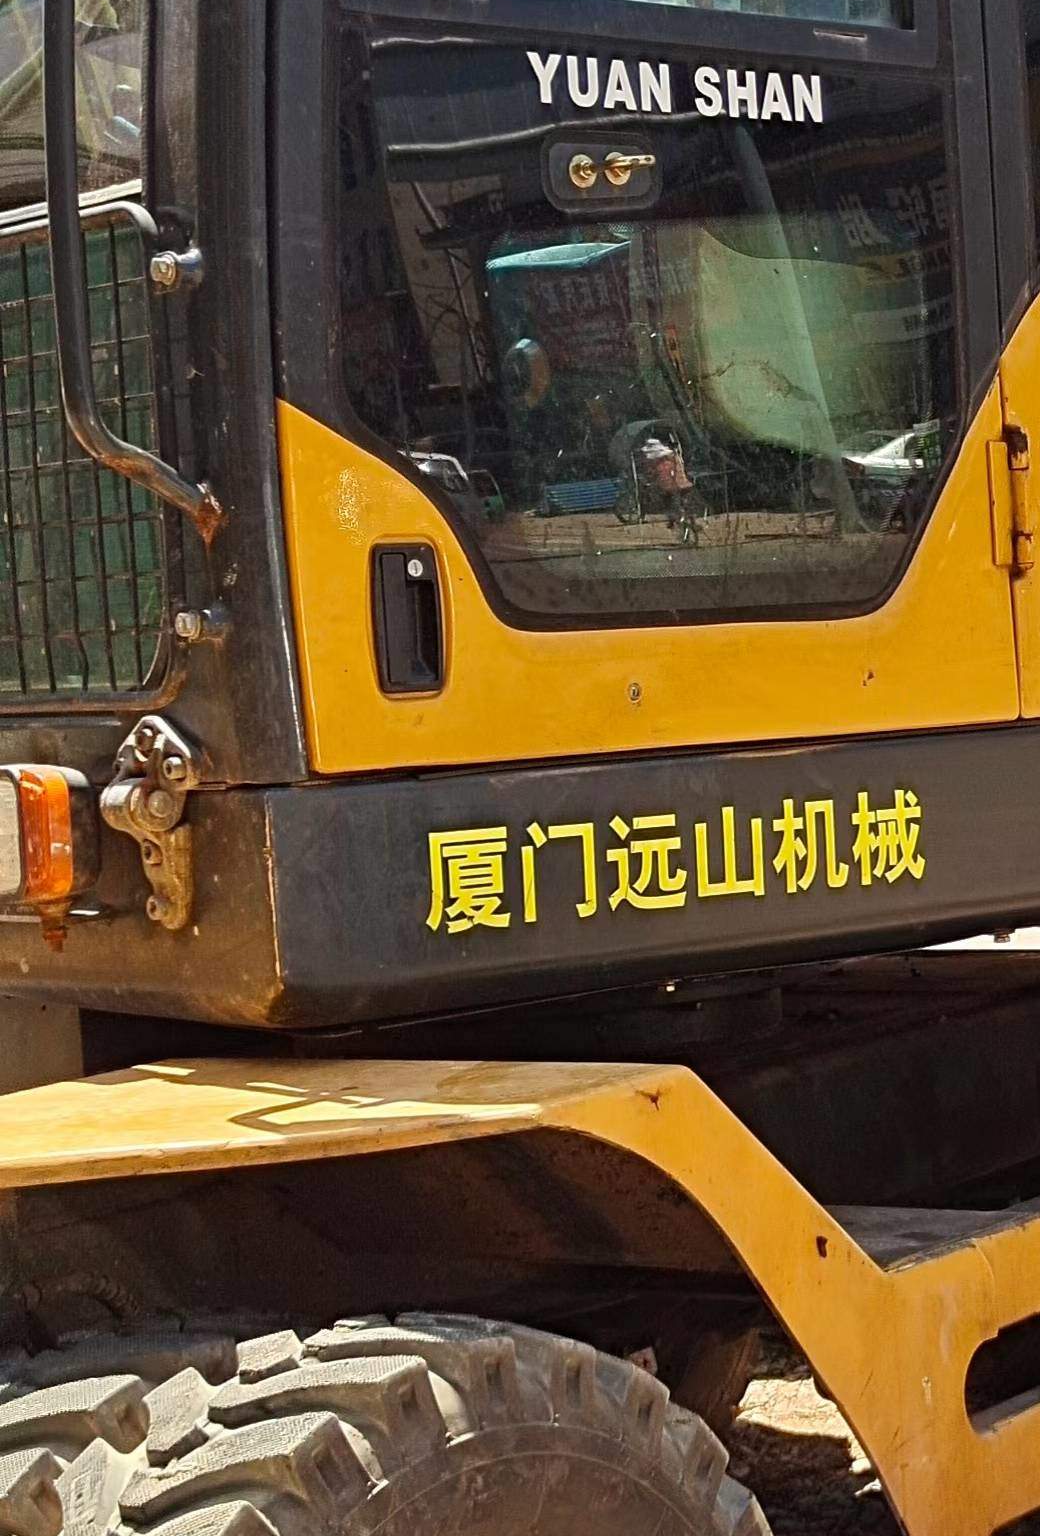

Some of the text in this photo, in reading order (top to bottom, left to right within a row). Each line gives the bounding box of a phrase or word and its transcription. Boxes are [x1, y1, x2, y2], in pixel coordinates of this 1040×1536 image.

[526, 52, 824, 123] YUAN SHAN
[425, 789, 927, 934] 厦门远山机械
